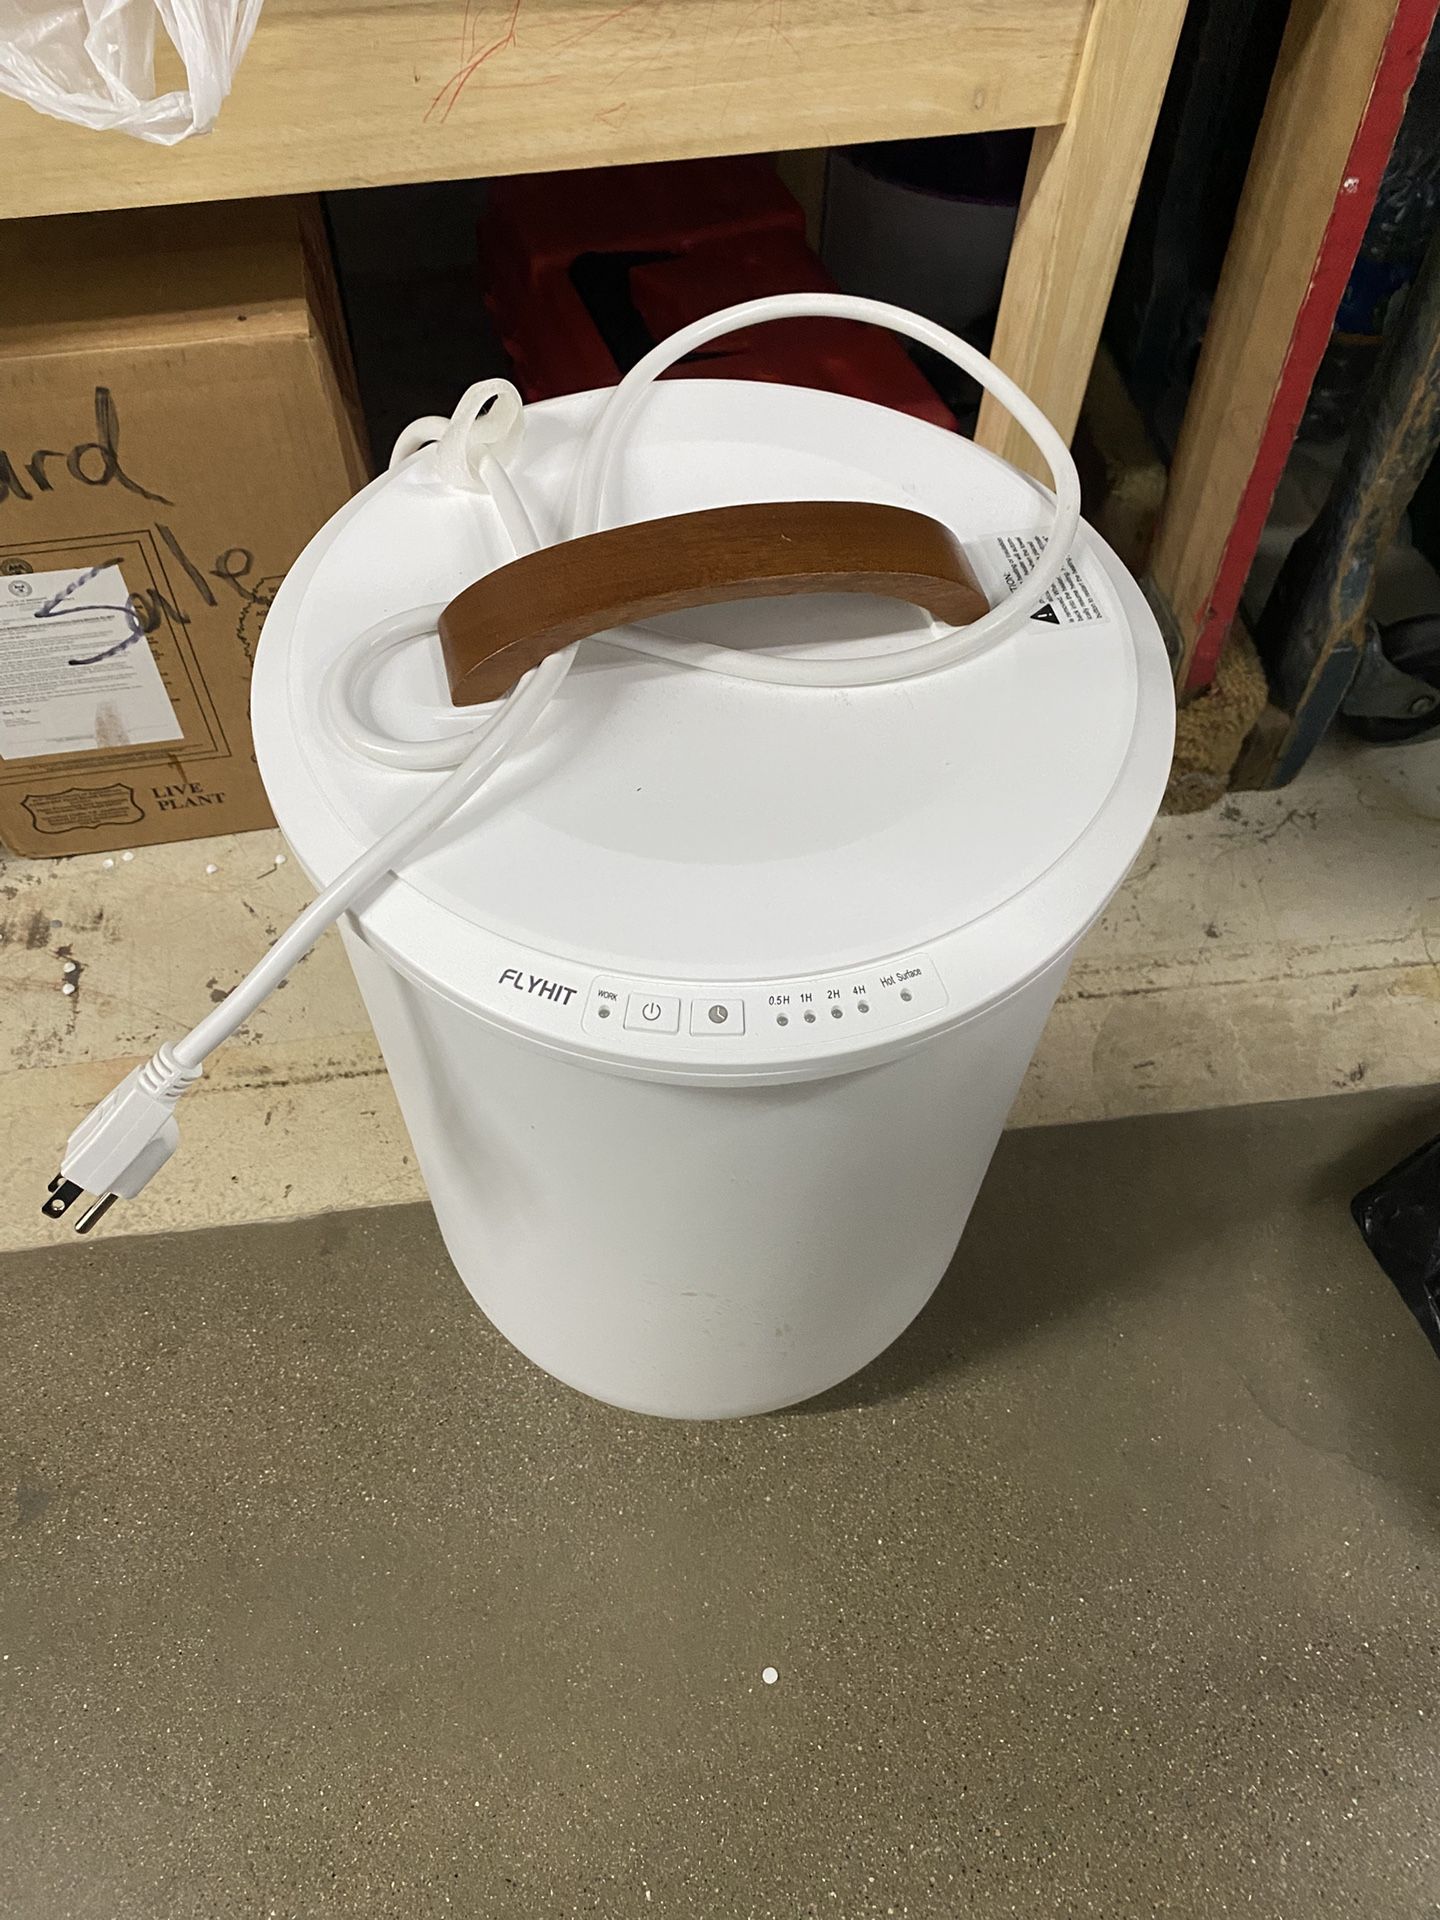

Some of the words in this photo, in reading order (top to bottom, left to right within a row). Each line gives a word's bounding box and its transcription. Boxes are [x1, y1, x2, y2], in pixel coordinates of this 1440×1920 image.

[34, 522, 273, 666] Sale
[151, 782, 203, 799] LIVE
[157, 792, 225, 811] PLANT
[498, 968, 578, 1005] FLYHIT
[879, 976, 896, 989] Hot
[897, 967, 922, 982] Surface
[597, 988, 619, 1001] WORK
[768, 995, 790, 1006] 0.5H
[800, 992, 812, 1003] 1H
[827, 989, 841, 1000] 2H
[852, 985, 866, 995] 4H
